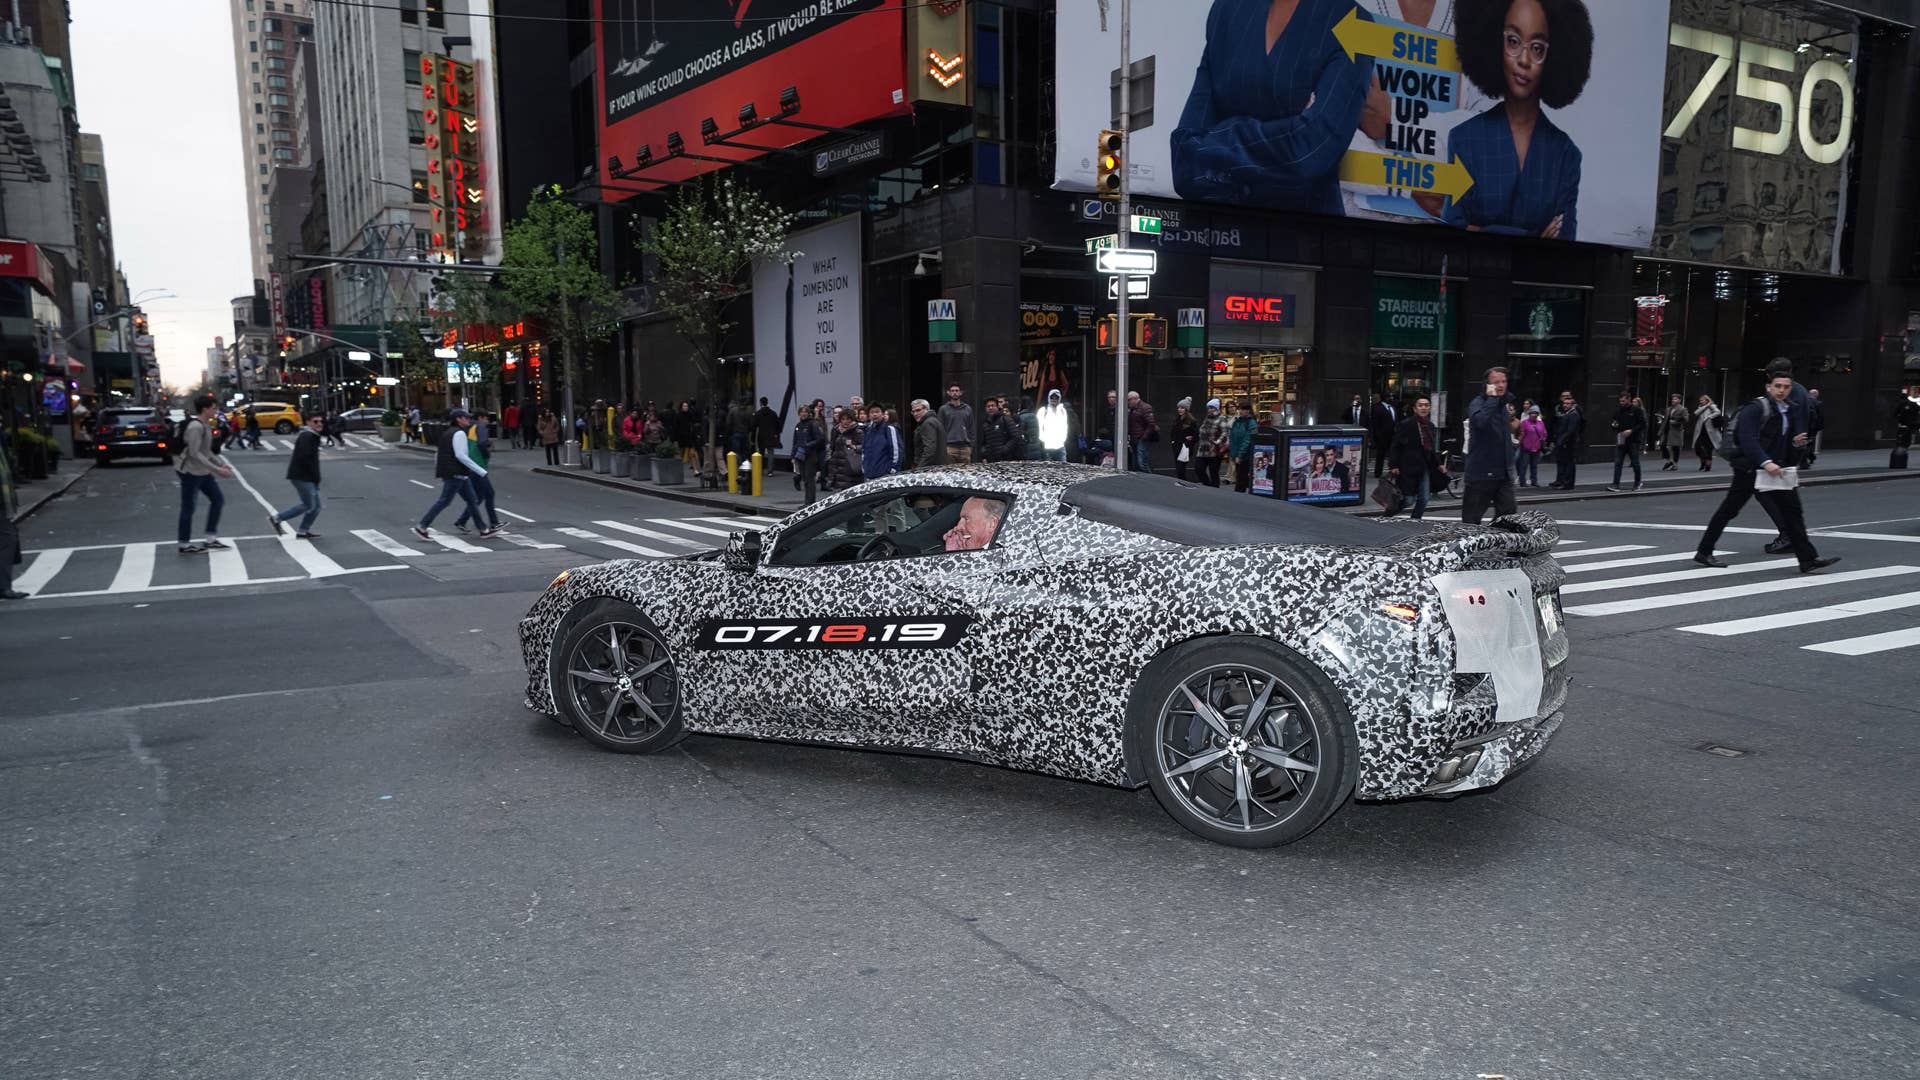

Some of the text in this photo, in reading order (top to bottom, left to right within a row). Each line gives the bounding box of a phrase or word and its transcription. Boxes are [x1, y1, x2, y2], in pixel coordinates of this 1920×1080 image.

[609, 100, 617, 115] IF
[616, 90, 637, 111] YOUR
[635, 80, 657, 102] WINE
[657, 68, 684, 92] COULD
[684, 49, 722, 80] CHOOSE
[723, 45, 731, 63] A
[732, 29, 766, 58] GLASS,
[767, 23, 776, 42] IT
[778, 4, 818, 37] WOULD
[819, 0, 834, 16] BE
[1391, 31, 1438, 65] SHE
[1376, 63, 1451, 103] WOKE
[1663, 23, 1855, 164] 750
[1395, 97, 1429, 126] UP
[1385, 123, 1436, 156] LIKE
[422, 58, 444, 246] BROOKLYN
[1383, 157, 1435, 190] THIS
[1141, 218, 1148, 231] 7
[1086, 240, 1093, 253] W
[1095, 238, 1105, 249] 49
[812, 257, 837, 275] WHAT
[803, 275, 849, 297] DIMENSION
[817, 299, 834, 315] ARE
[1225, 296, 1282, 314] GNC
[1225, 312, 1281, 322] LIVE WELL
[1391, 314, 1435, 329] COFFEE
[817, 320, 835, 335] YOU
[815, 340, 837, 355] EVEN
[820, 361, 833, 375] IN?
[714, 623, 946, 643] 07.18.19
